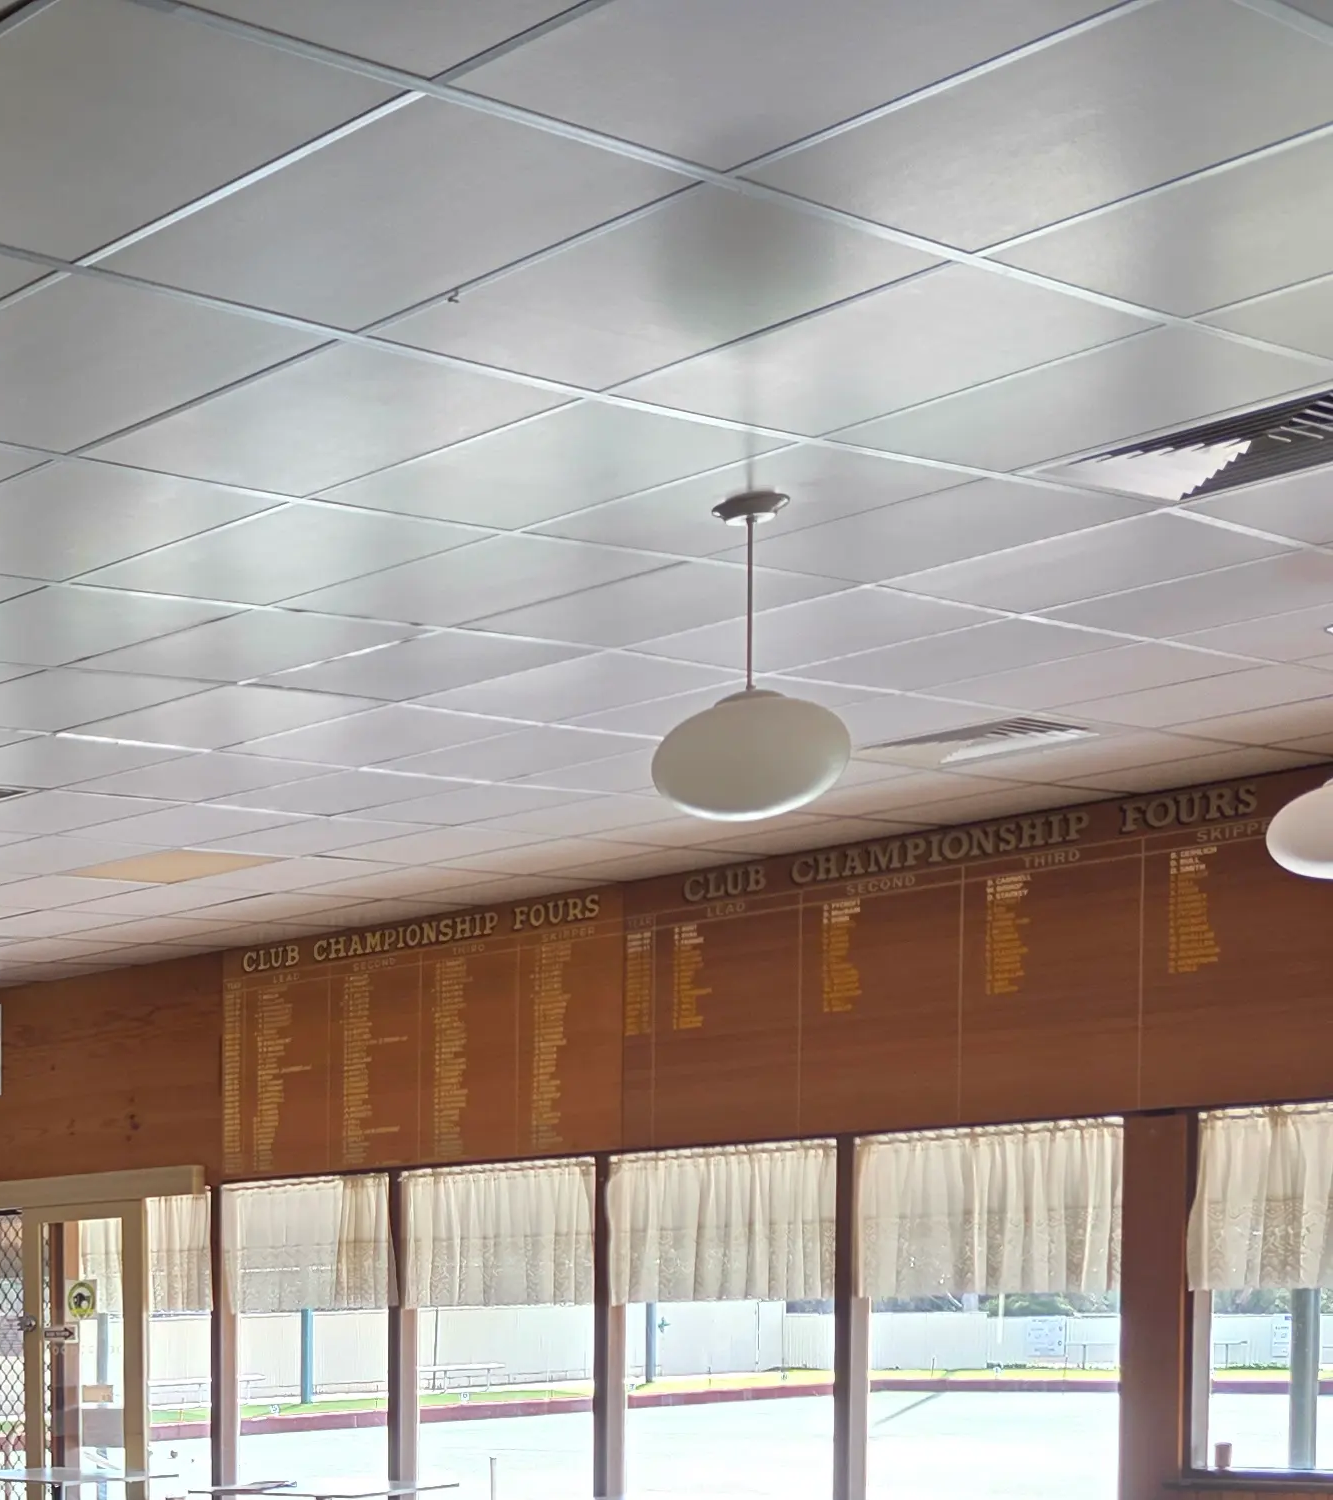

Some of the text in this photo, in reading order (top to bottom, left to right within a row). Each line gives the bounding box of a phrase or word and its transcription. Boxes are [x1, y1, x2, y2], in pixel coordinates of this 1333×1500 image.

[683, 784, 1257, 901] CLUB CHAMPIONSHIP FOURS
[1023, 848, 1081, 868] THIRD
[845, 875, 916, 896] SECOND
[707, 901, 746, 918] LEAD
[243, 894, 600, 972] CLUB CHAMPIONSHIP FOURS
[541, 926, 595, 943] SKIPPER
[453, 944, 485, 955] THIRD
[353, 956, 397, 972] SECOND
[273, 972, 300, 984] LEAD
